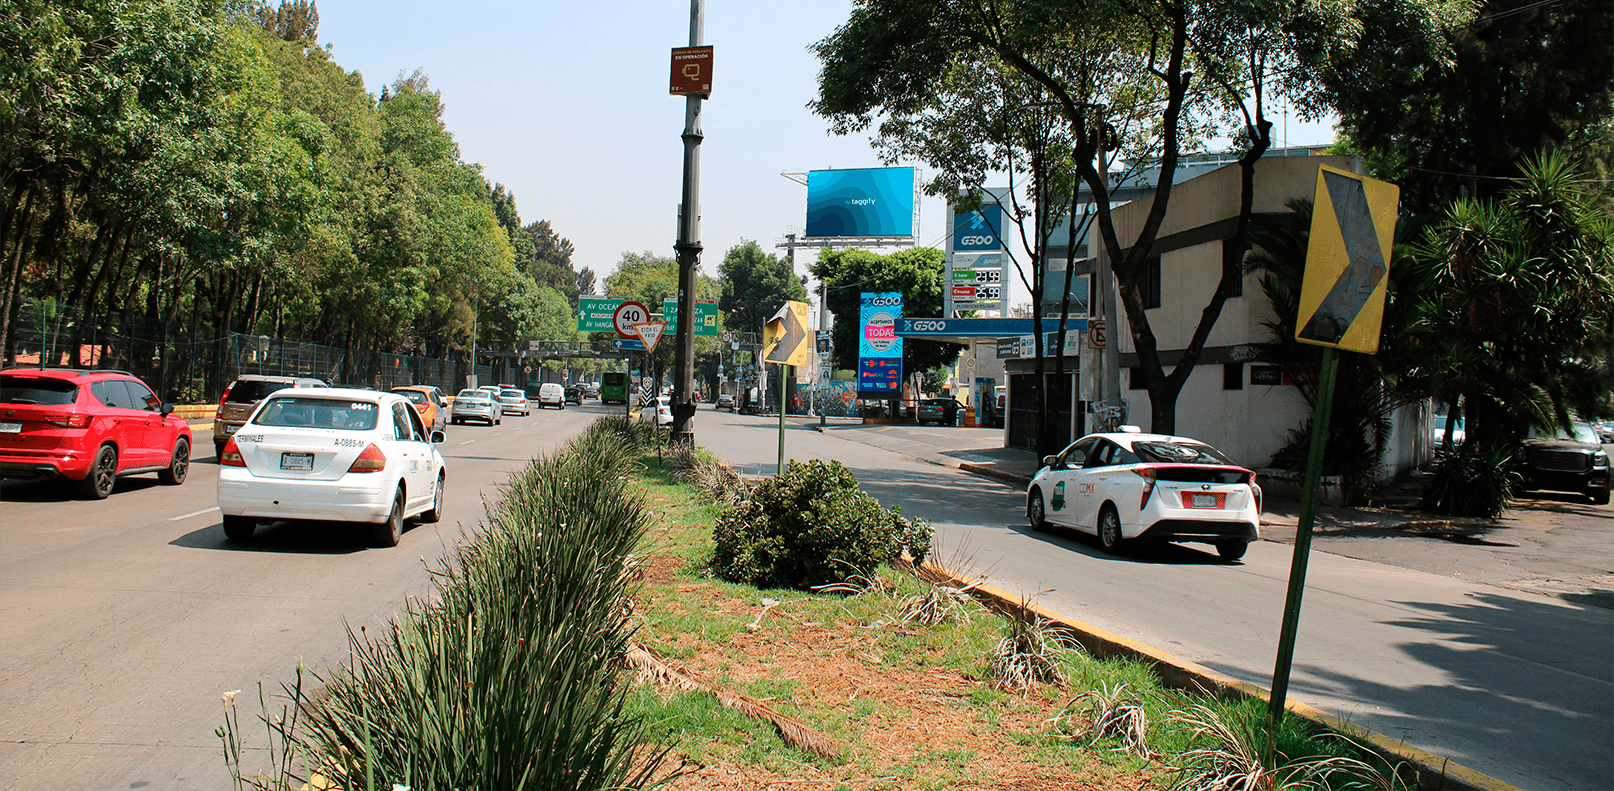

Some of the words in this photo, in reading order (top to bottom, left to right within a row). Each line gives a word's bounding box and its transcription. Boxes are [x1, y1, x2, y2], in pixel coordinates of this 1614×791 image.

[851, 198, 876, 206] taggify
[961, 235, 993, 245] G500
[873, 296, 901, 306] G500
[622, 310, 640, 322] 40
[913, 321, 946, 331] G500
[868, 329, 895, 337] TODAS
[351, 403, 372, 411] 0441
[237, 435, 264, 443] TERMINALES
